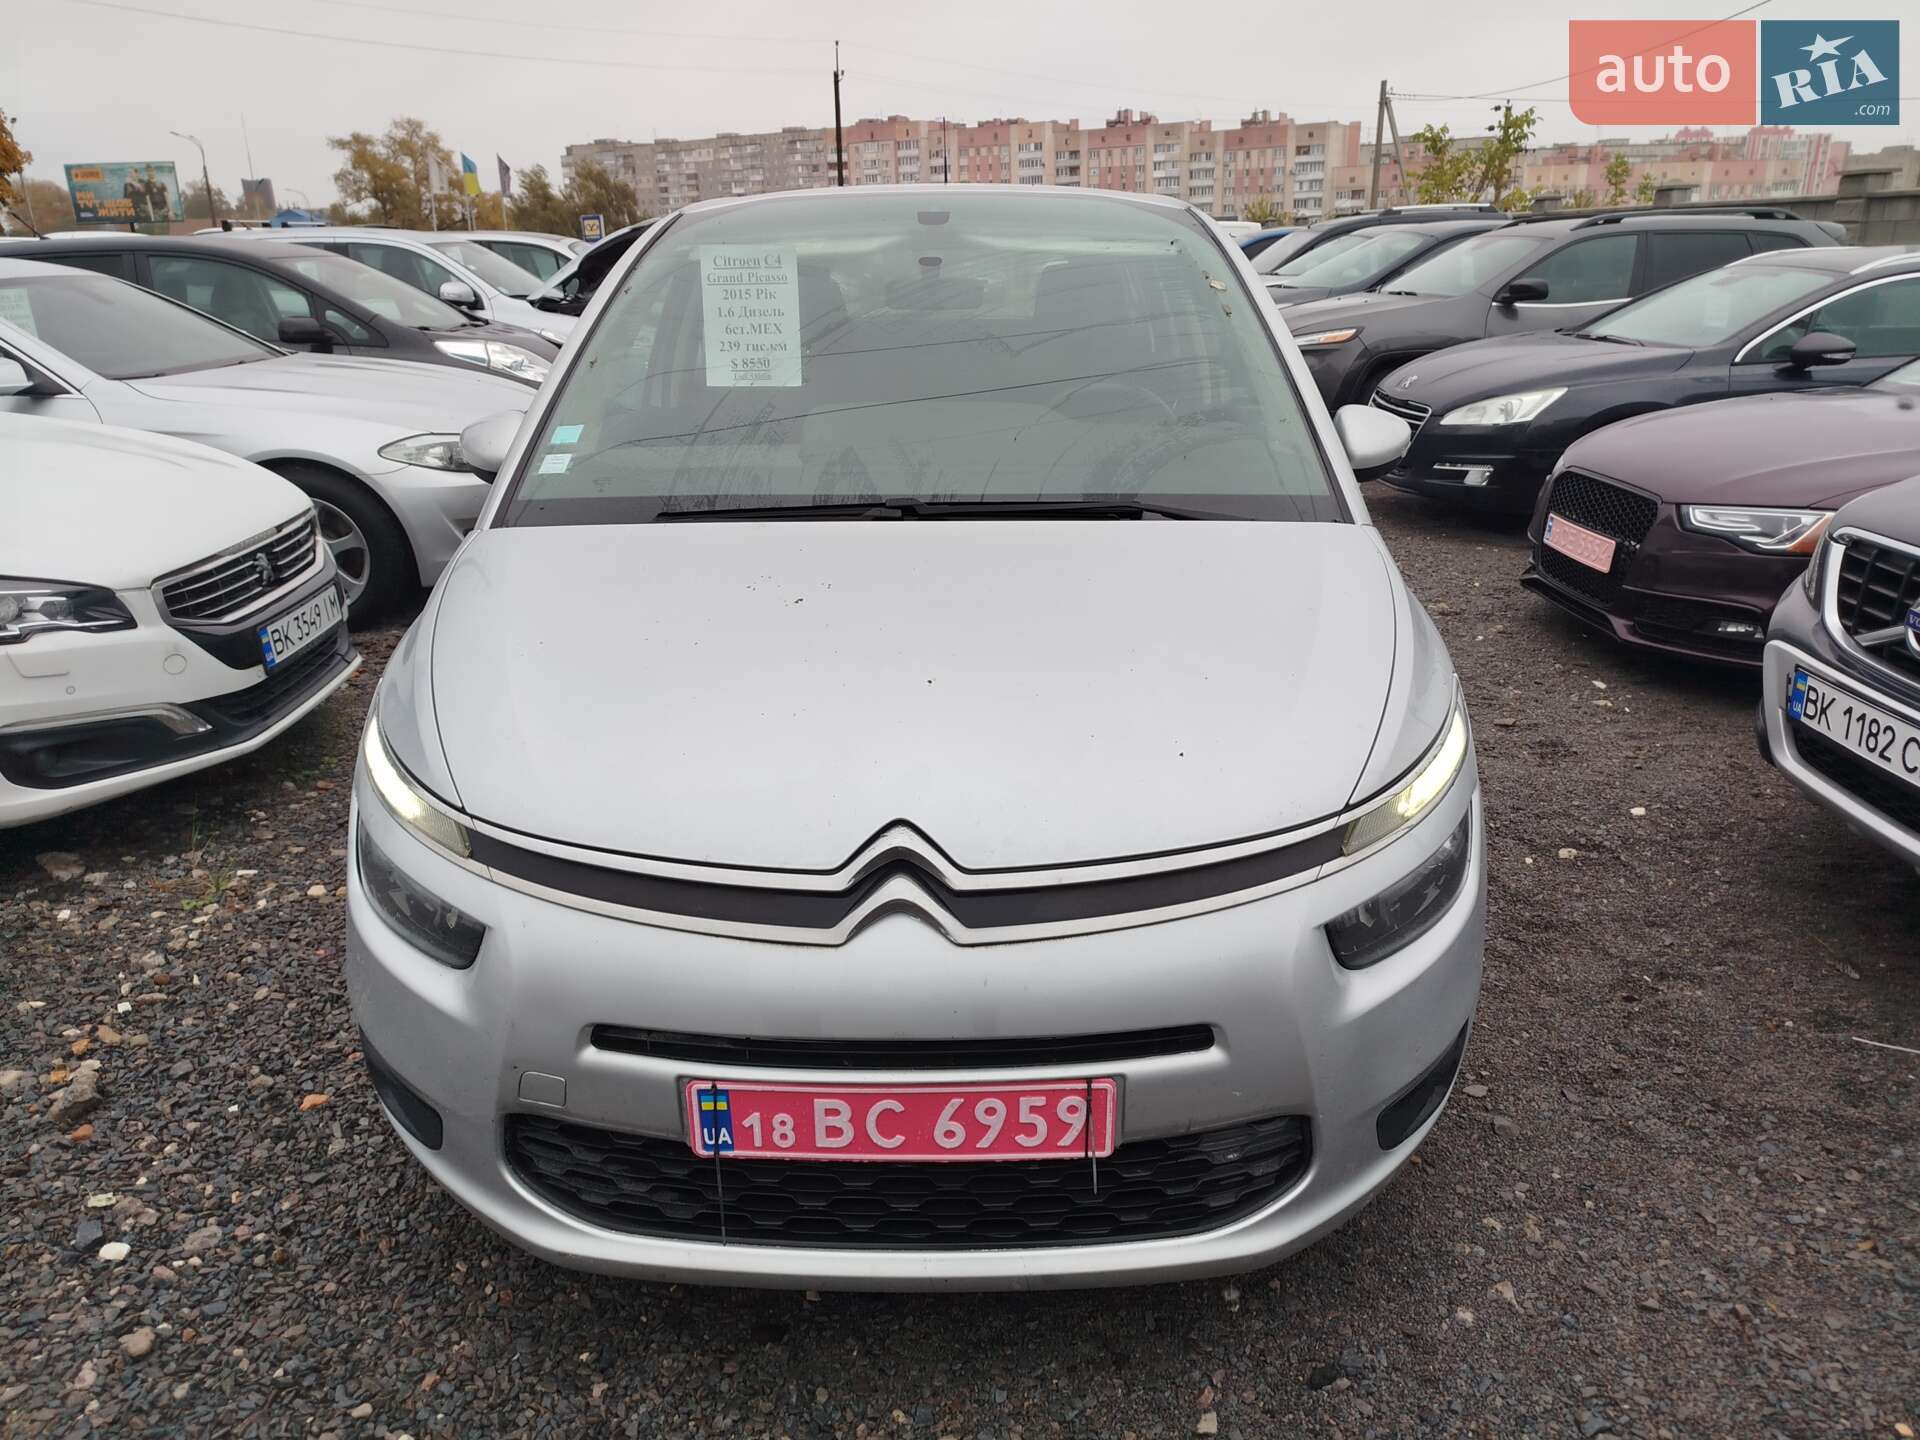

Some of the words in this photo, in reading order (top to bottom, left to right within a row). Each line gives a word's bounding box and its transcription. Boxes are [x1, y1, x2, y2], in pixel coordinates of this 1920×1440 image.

[97, 207, 135, 217] ЖИТИ
[713, 255, 761, 267] Citroen
[764, 254, 782, 266] C4
[707, 272, 744, 283] Grand
[747, 271, 788, 283] Picasso
[722, 288, 752, 300] 2015
[756, 287, 777, 300] Рік
[717, 306, 735, 318] 1.6
[737, 306, 785, 321] Дизель
[725, 322, 783, 335] 6ст.МЕХ
[719, 340, 741, 352] 239
[271, 620, 296, 656] BK
[293, 603, 322, 641] 3549
[323, 591, 339, 622] IM
[1792, 701, 1802, 713] UA
[1803, 684, 1836, 732] BK
[1843, 706, 1896, 764] 1182
[703, 1127, 733, 1146] UA
[741, 1111, 796, 1149] 18
[813, 1097, 906, 1150] BC
[932, 1095, 1089, 1150] 6959
